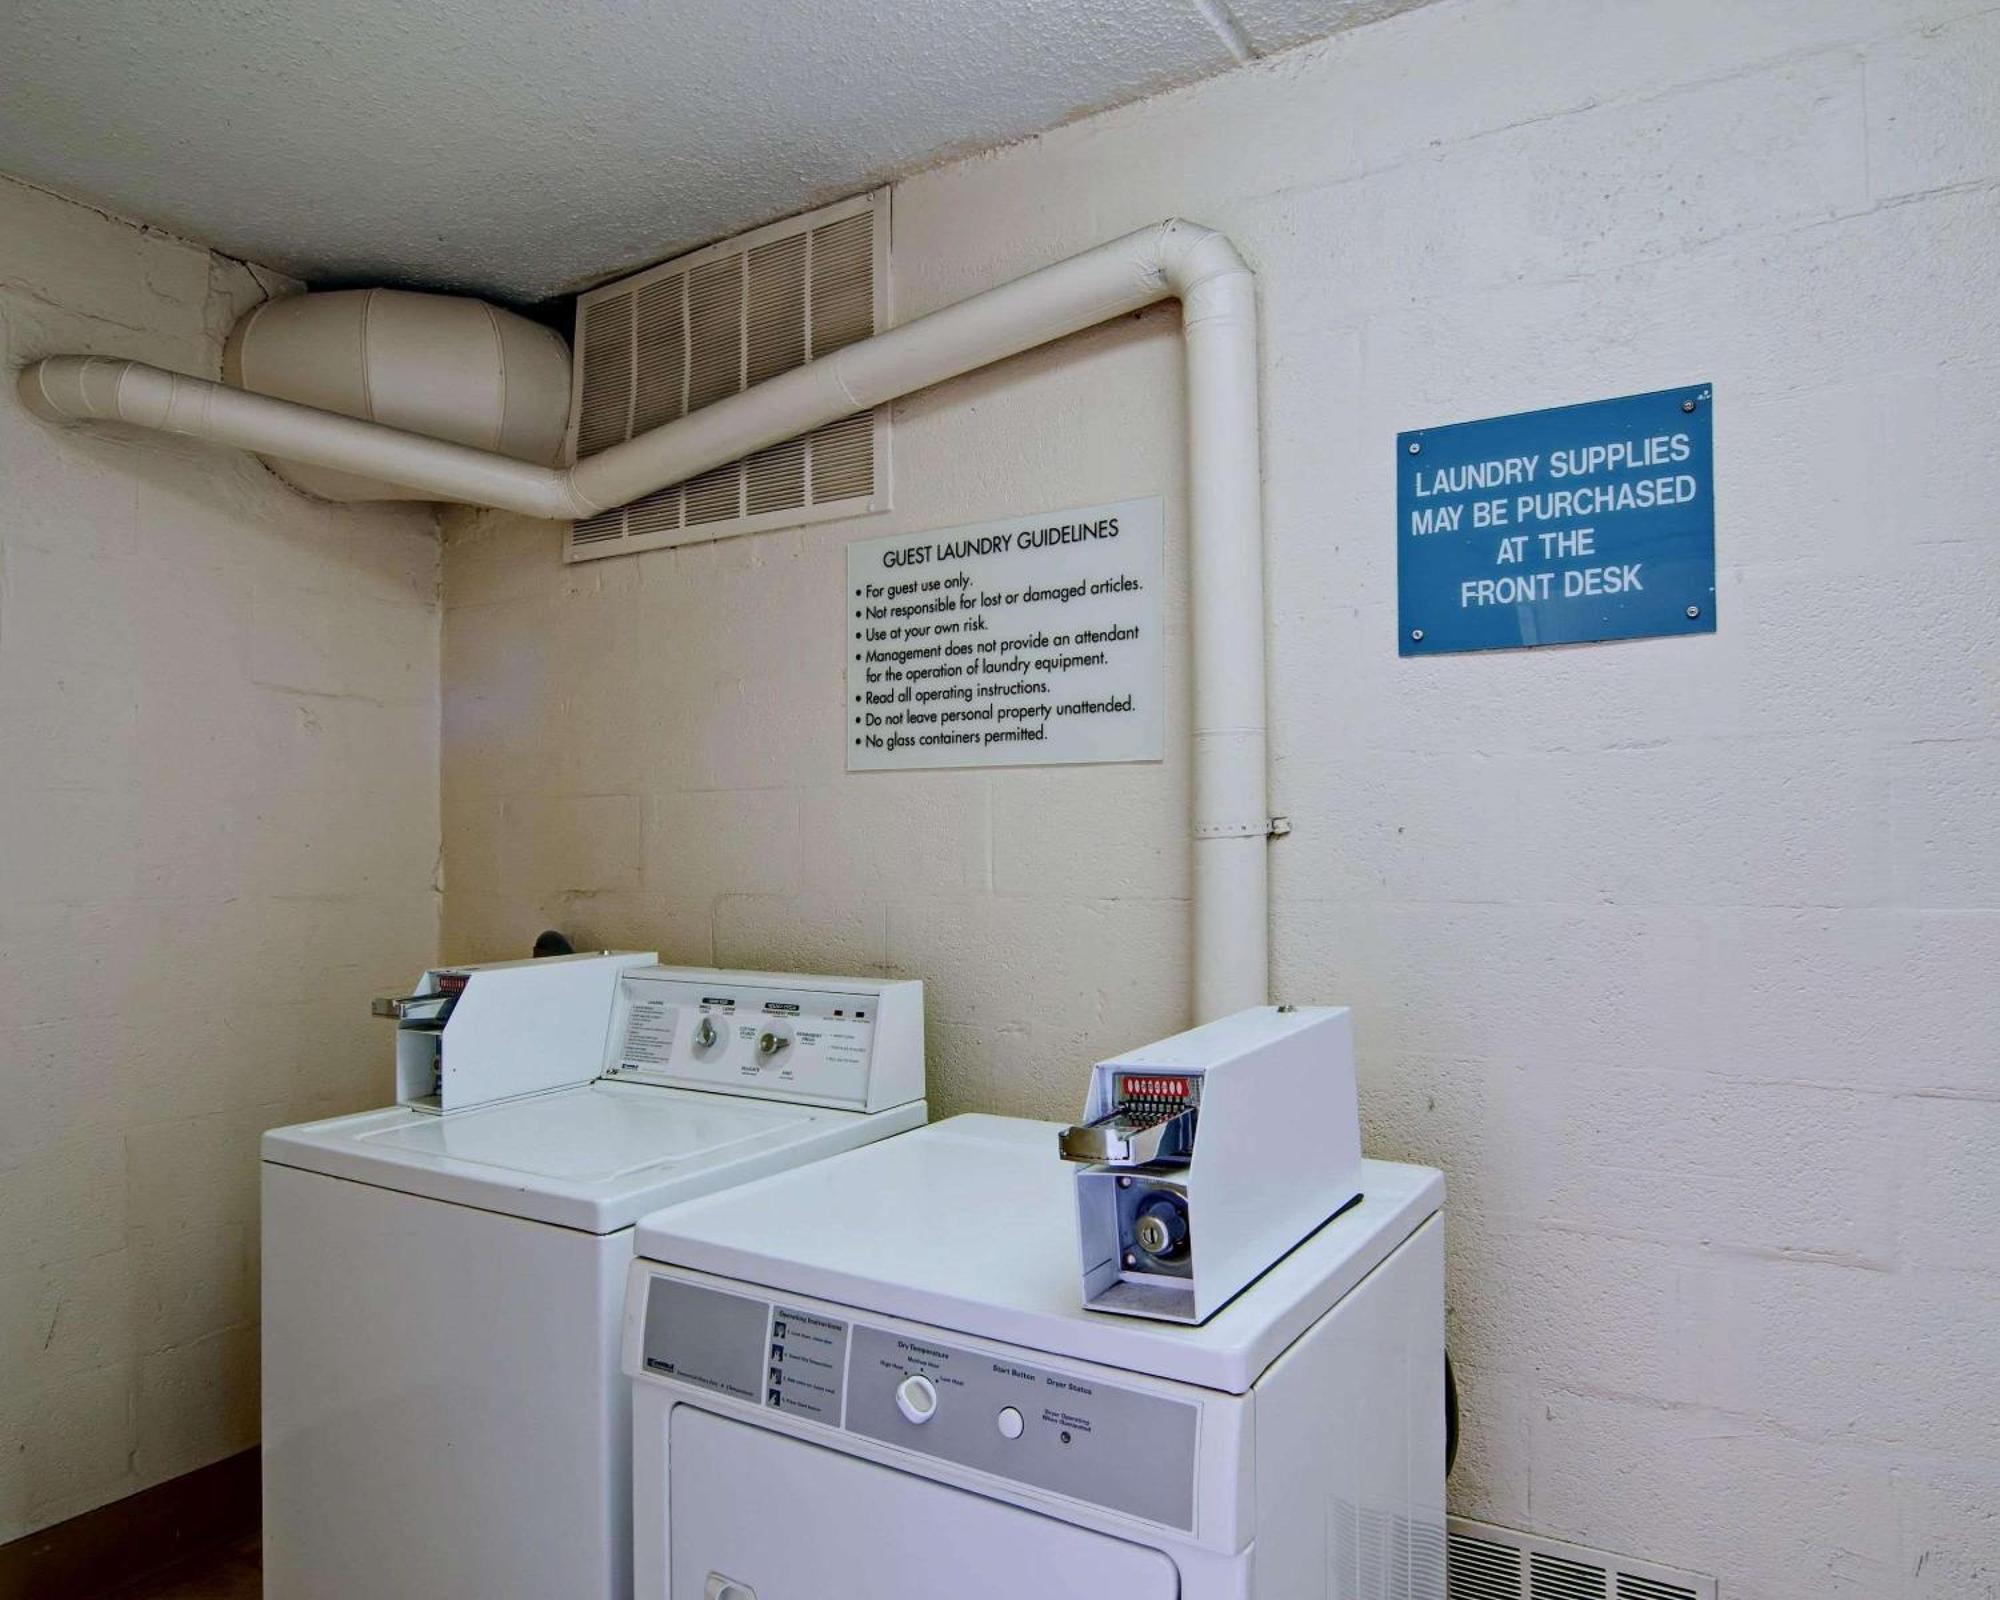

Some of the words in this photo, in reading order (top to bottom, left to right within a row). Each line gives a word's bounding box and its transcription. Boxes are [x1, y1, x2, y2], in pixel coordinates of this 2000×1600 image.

[1416, 455, 1539, 497] LAUNDRY
[1550, 434, 1690, 478] SUPPLIES
[1412, 505, 1463, 536] MAY
[1473, 499, 1508, 528] BE
[1517, 475, 1697, 523] PURCHASED
[883, 545, 932, 568] GUEST
[936, 534, 1012, 561] LAUNDRY
[1017, 518, 1119, 549] GUIDELINES
[1496, 536, 1528, 564] AT
[1539, 528, 1595, 559] THE
[866, 585, 884, 598] For
[887, 581, 918, 600] guest
[921, 579, 940, 591] use
[944, 572, 973, 590] only.
[866, 606, 887, 619] Not
[890, 598, 956, 621] responsible
[959, 596, 976, 610] for
[980, 593, 1002, 607] lost
[1005, 593, 1019, 604] or
[1023, 585, 1086, 604] damaged
[1090, 574, 1143, 595] articles.
[1461, 573, 1554, 607] FRONT
[1564, 564, 1643, 597] DESK
[866, 628, 887, 641] Use
[890, 628, 901, 639] at
[904, 624, 931, 641] your
[934, 622, 960, 634] own
[963, 616, 988, 631] risk.
[866, 646, 941, 666] Management
[945, 642, 973, 657] does
[977, 641, 997, 653] not
[1001, 632, 1049, 655] provide
[1053, 635, 1070, 646] an
[1074, 624, 1139, 644] attendant
[866, 670, 882, 683] for
[885, 669, 902, 681] the
[906, 664, 962, 684] operation
[967, 663, 980, 675] of
[983, 656, 1029, 677] laundry
[1035, 651, 1108, 673] equipment.
[866, 690, 895, 704] Read
[898, 689, 912, 702] all
[915, 686, 973, 705] operating
[977, 680, 1050, 697] instructions.
[866, 712, 882, 726] Do
[885, 712, 904, 724] not
[907, 709, 937, 723] leave
[940, 700, 993, 725] personal
[998, 700, 1051, 722] property
[1056, 695, 1135, 716] unattended.
[866, 734, 883, 748] No
[887, 734, 916, 751] glass
[919, 729, 980, 745] containers
[984, 725, 1047, 746] permitted.
[898, 1341, 909, 1350] Dry
[910, 1344, 949, 1359] Temperature
[993, 1364, 1010, 1375] Start
[1012, 1370, 1035, 1381] Button
[1047, 1378, 1067, 1388] Dryer
[1069, 1384, 1092, 1395] Status
